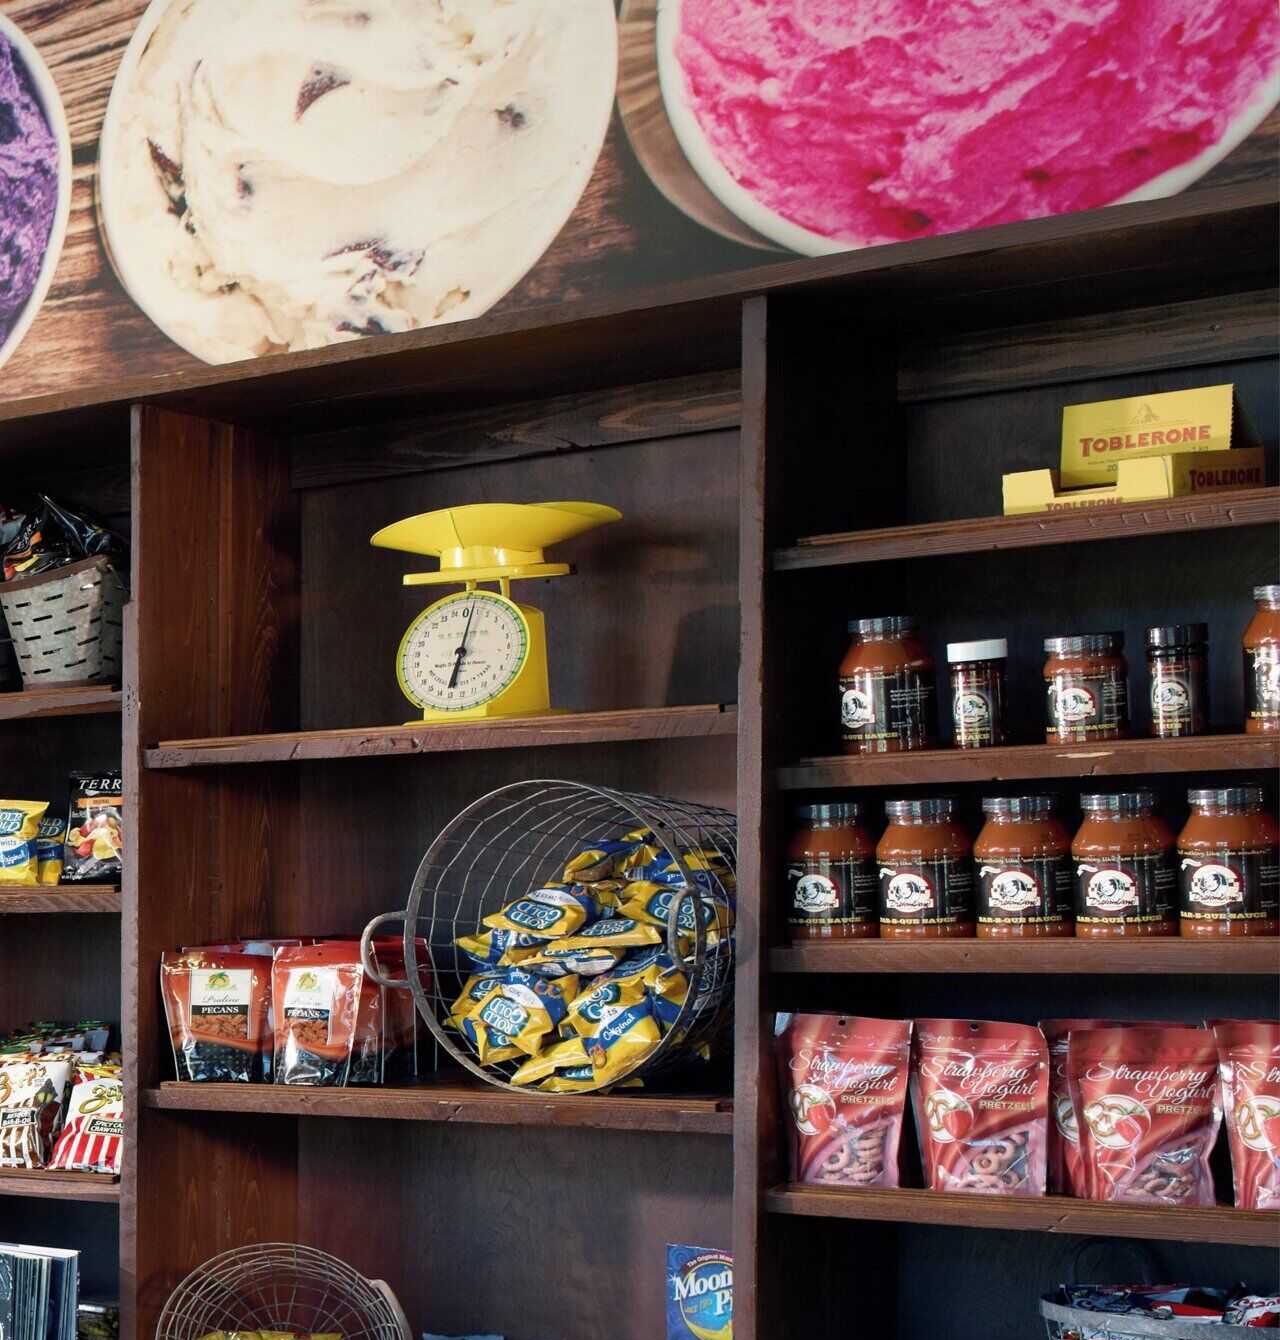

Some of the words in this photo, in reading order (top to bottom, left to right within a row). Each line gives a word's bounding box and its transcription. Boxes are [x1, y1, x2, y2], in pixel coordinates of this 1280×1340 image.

[1080, 425, 1210, 457] TOBLERONE
[1190, 468, 1262, 491] TOBLERONE
[462, 608, 469, 617] 0
[79, 779, 122, 790] TERR
[1029, 915, 1062, 923] SAUCE
[1127, 915, 1162, 923] SAUCE
[287, 1009, 320, 1018] PECANS
[790, 1051, 890, 1082] Strawberry
[921, 1056, 1030, 1085] Strawberry
[1086, 1061, 1207, 1088] Strawberry
[824, 1070, 896, 1097] Yogurt
[960, 1075, 1037, 1103] Yogurt
[1135, 1081, 1216, 1105] Yogurt
[841, 1095, 896, 1105] PRETZELS
[979, 1100, 1036, 1110] PRETZELS
[687, 1259, 697, 1268] The
[697, 1254, 718, 1262] Original
[674, 1269, 732, 1301] Moon
[714, 1289, 732, 1316] Pi
